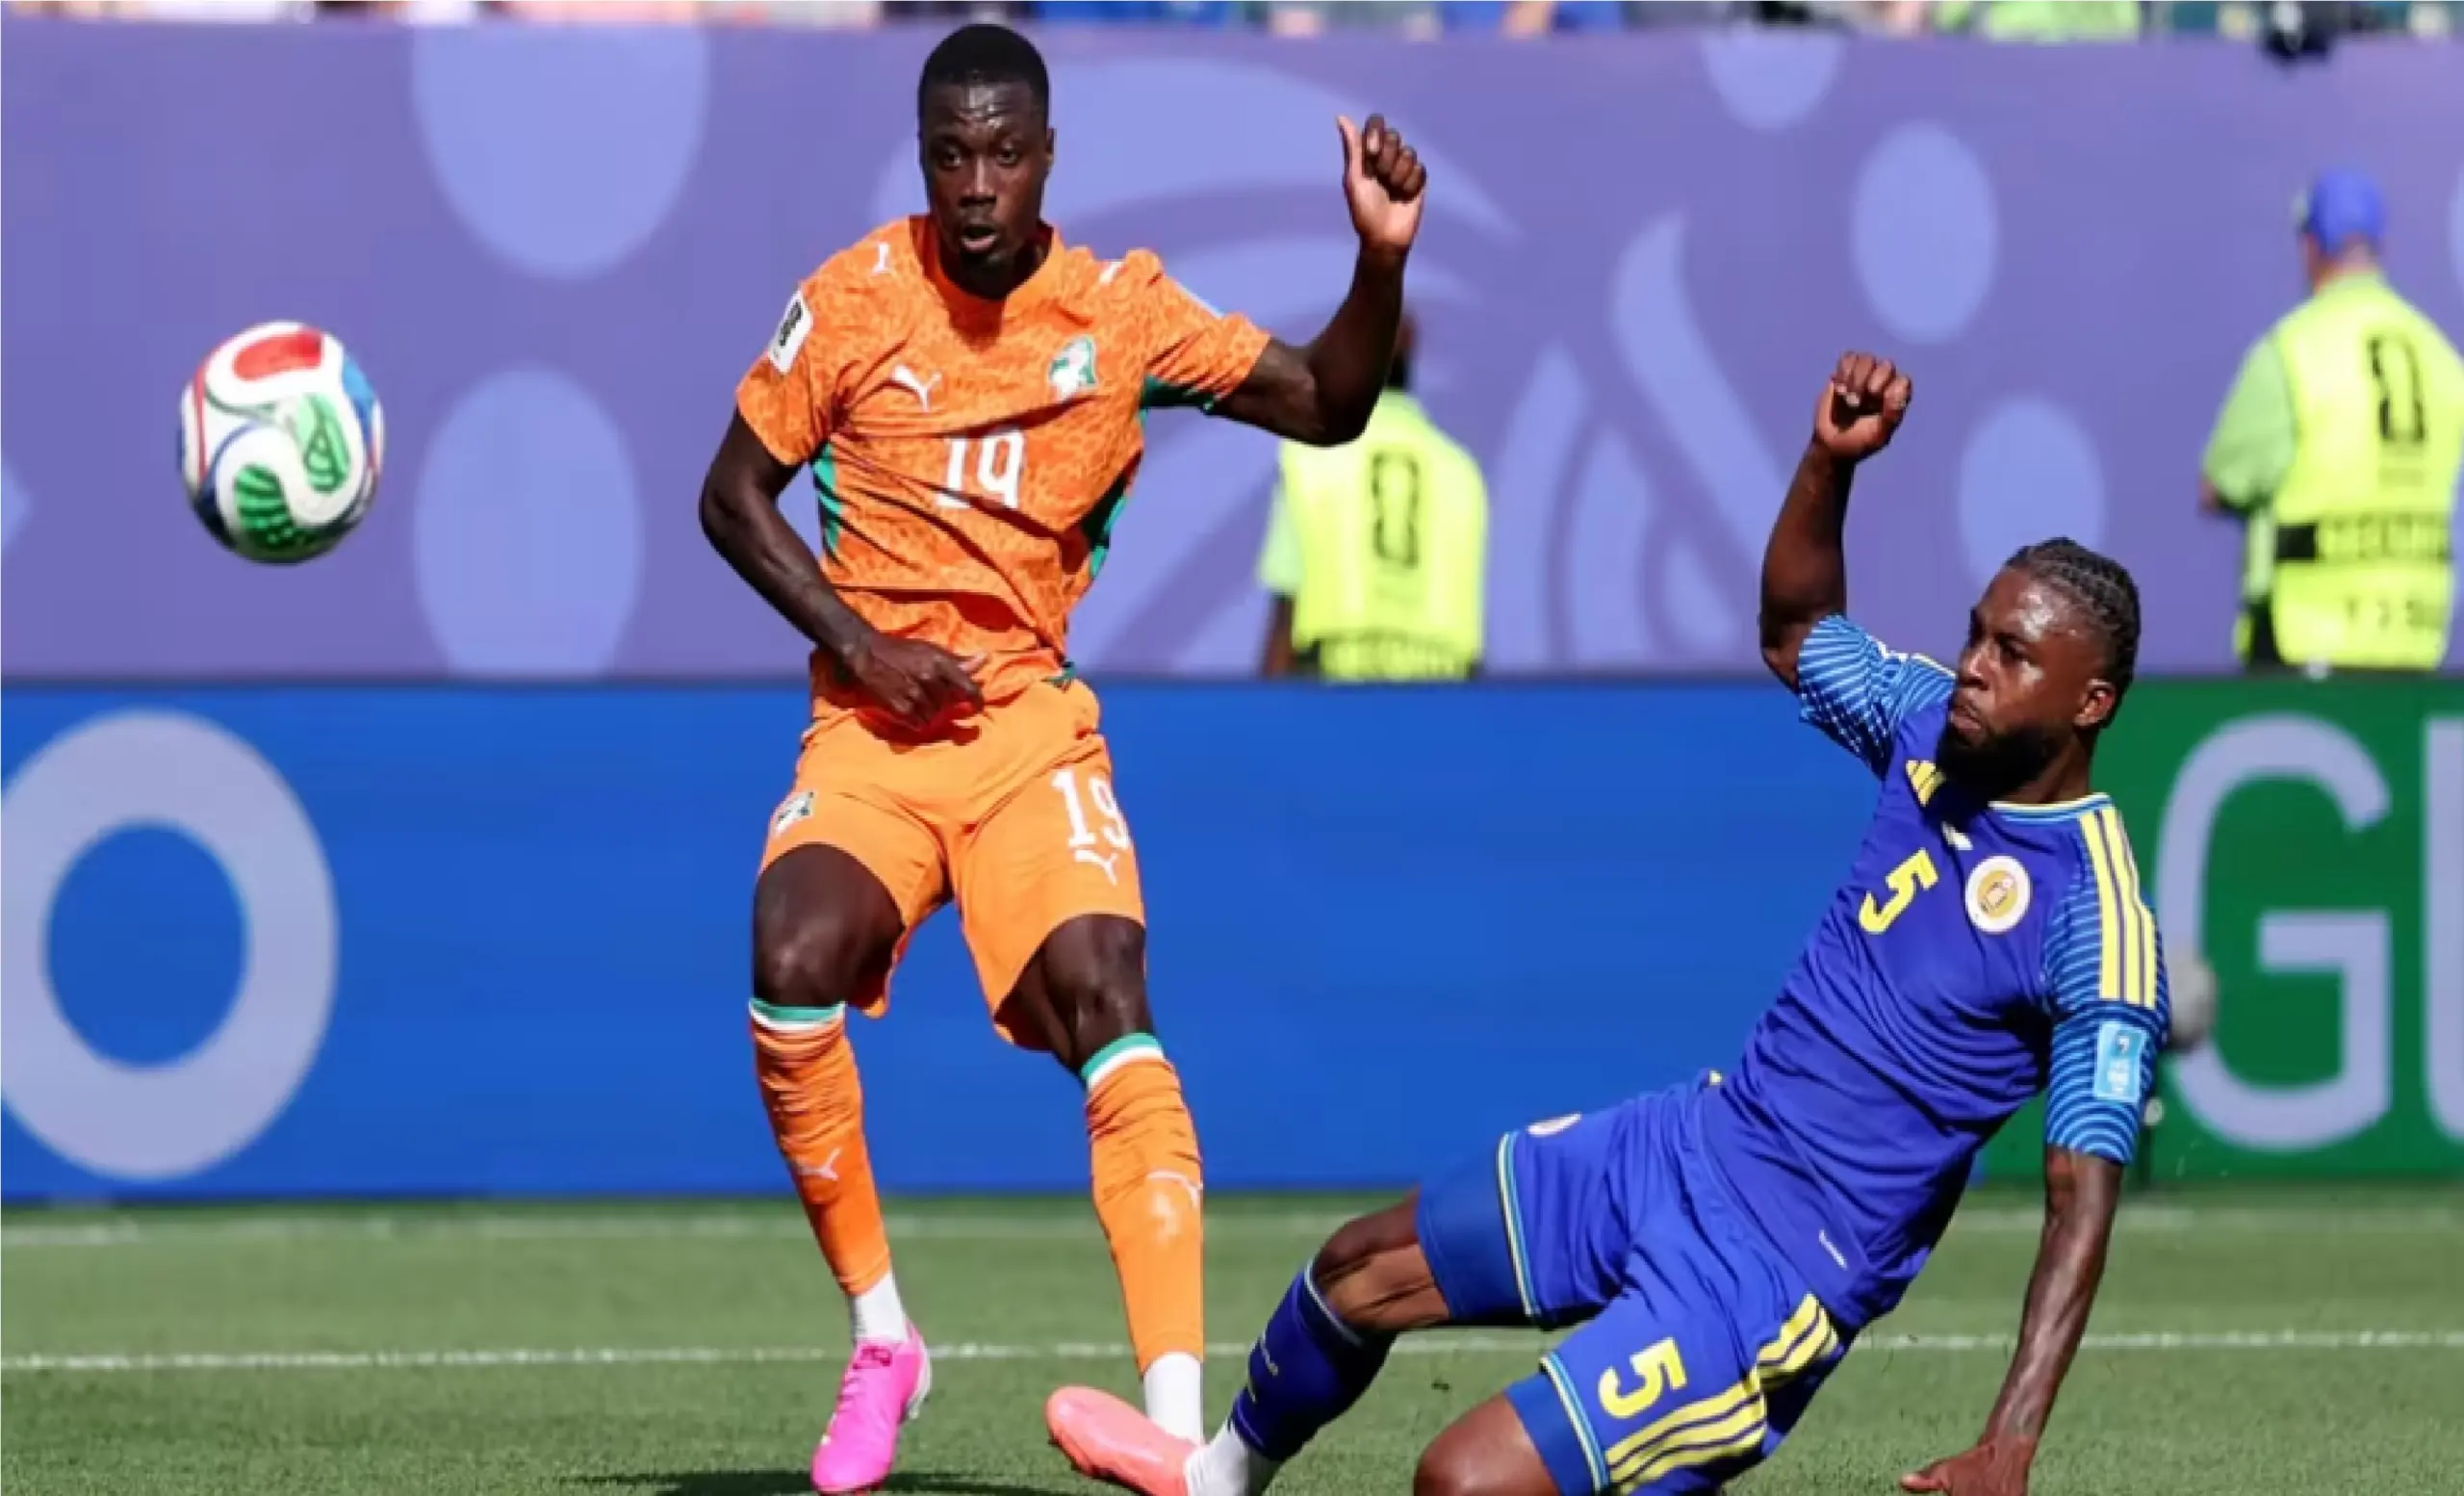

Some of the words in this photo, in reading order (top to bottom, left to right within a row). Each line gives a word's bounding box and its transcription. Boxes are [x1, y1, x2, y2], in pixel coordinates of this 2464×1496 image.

[937, 429, 1026, 509] 19
[1050, 770, 1130, 851] 19
[1858, 847, 1938, 935] 5
[2157, 710, 2464, 1151] G
[1599, 1336, 1687, 1419] 5
